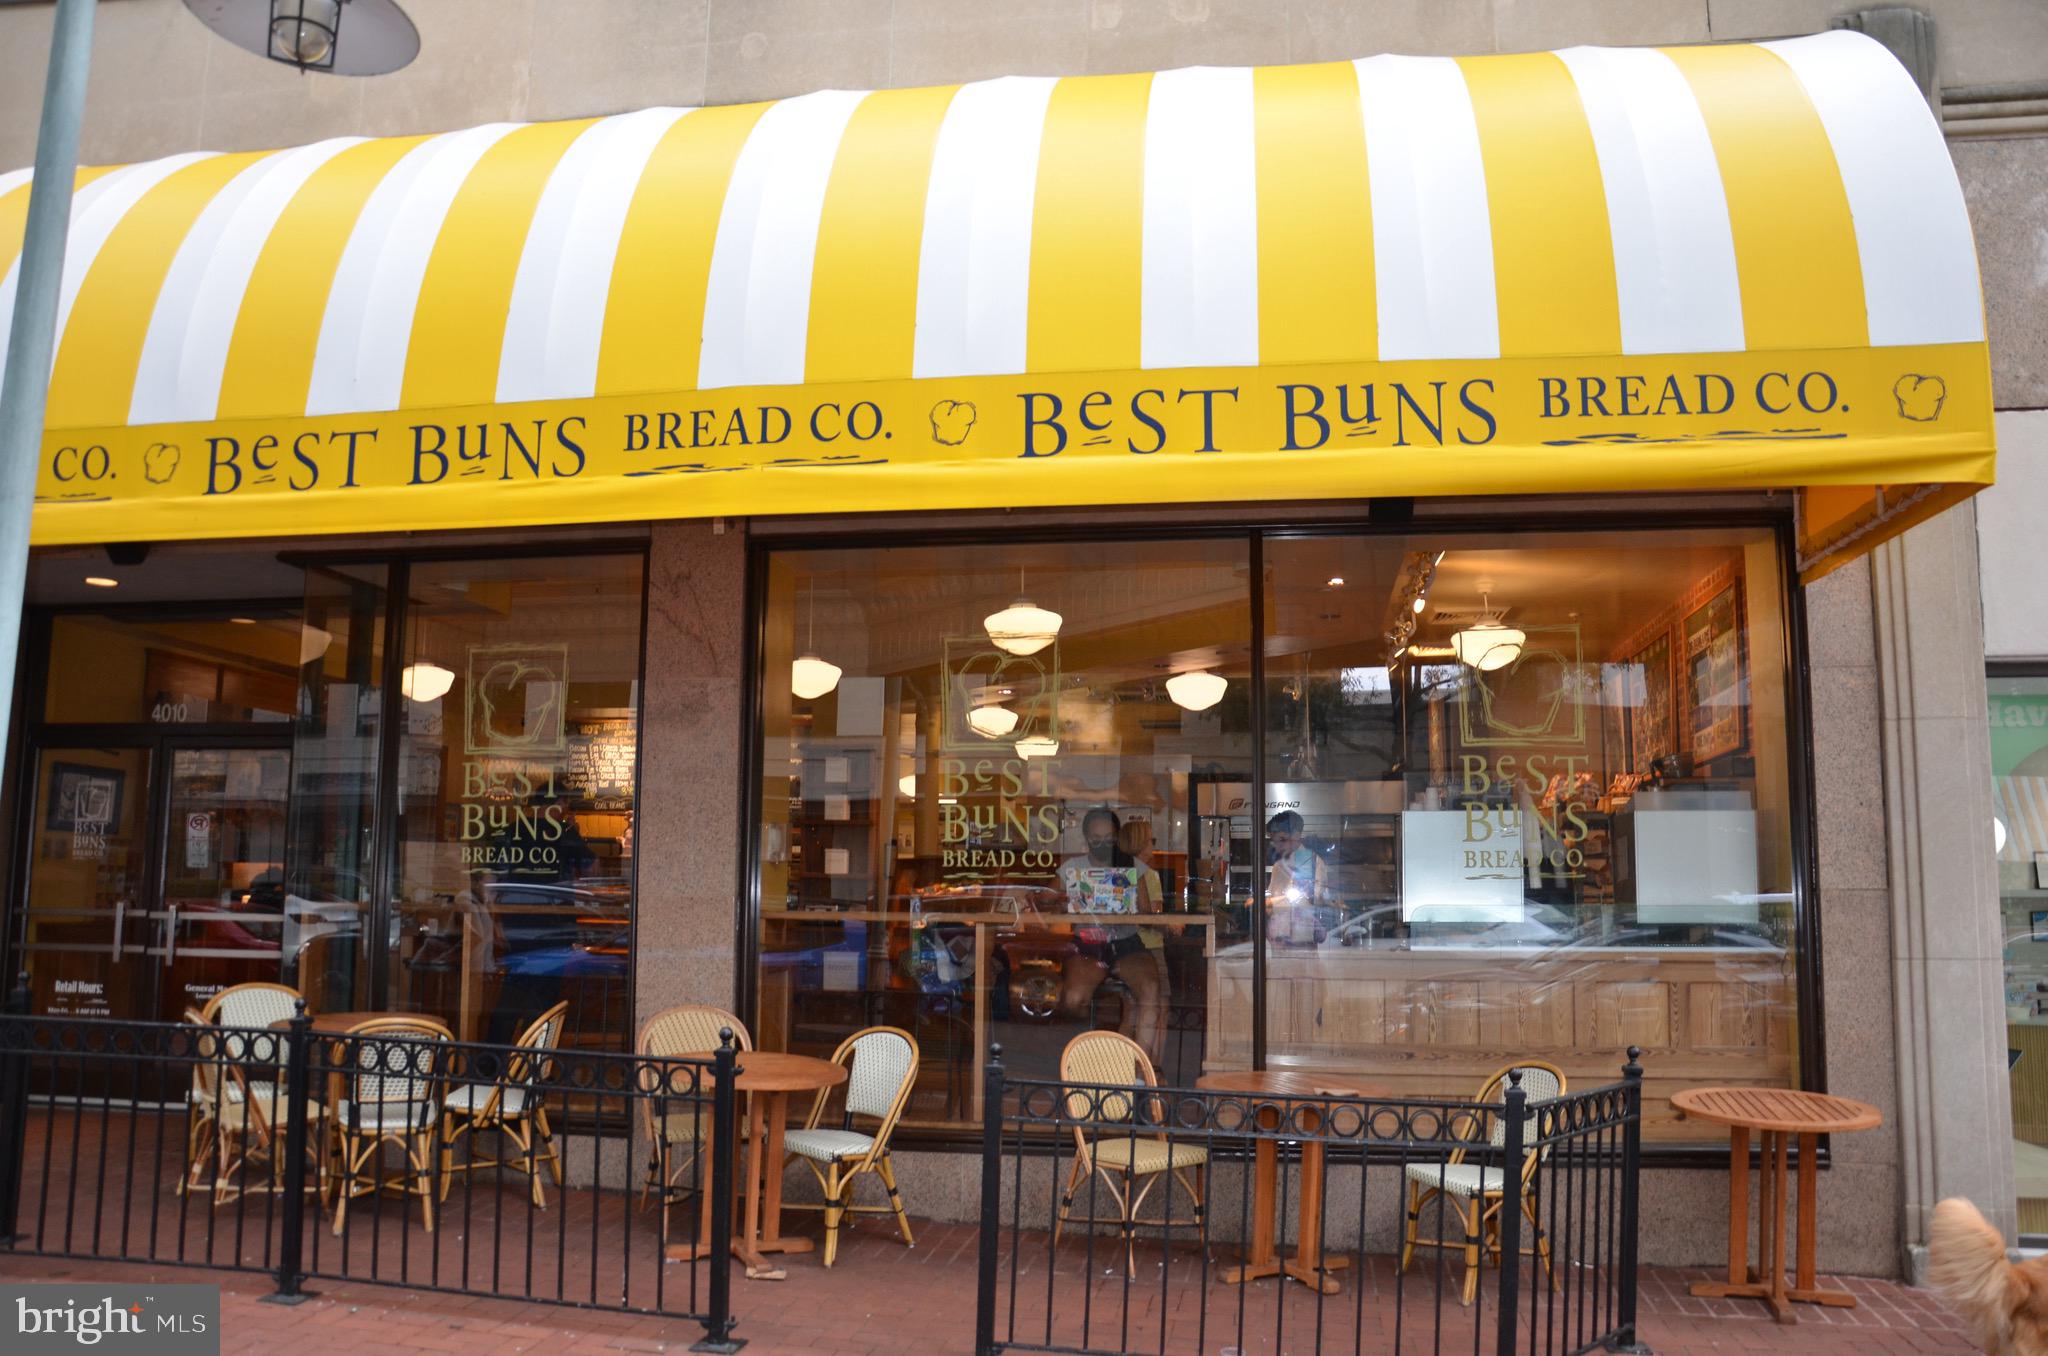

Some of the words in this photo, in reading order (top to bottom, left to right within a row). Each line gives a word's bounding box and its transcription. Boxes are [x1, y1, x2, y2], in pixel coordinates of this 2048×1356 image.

[1538, 371, 1736, 419] BREAD
[1755, 371, 1851, 414] CO.
[623, 405, 792, 452] BREAD
[810, 401, 893, 443] CO.
[52, 445, 117, 481] CO.
[152, 703, 187, 722] 4010
[460, 846, 524, 864] BREAD
[529, 847, 560, 864] CO.
[941, 850, 1016, 868] BREAD
[1021, 850, 1057, 868] CO.
[1463, 849, 1543, 869] BREAD
[1550, 848, 1587, 868] CO.
[55, 979, 78, 994] Retail
[78, 981, 104, 995] Hours:
[185, 983, 215, 993] General
